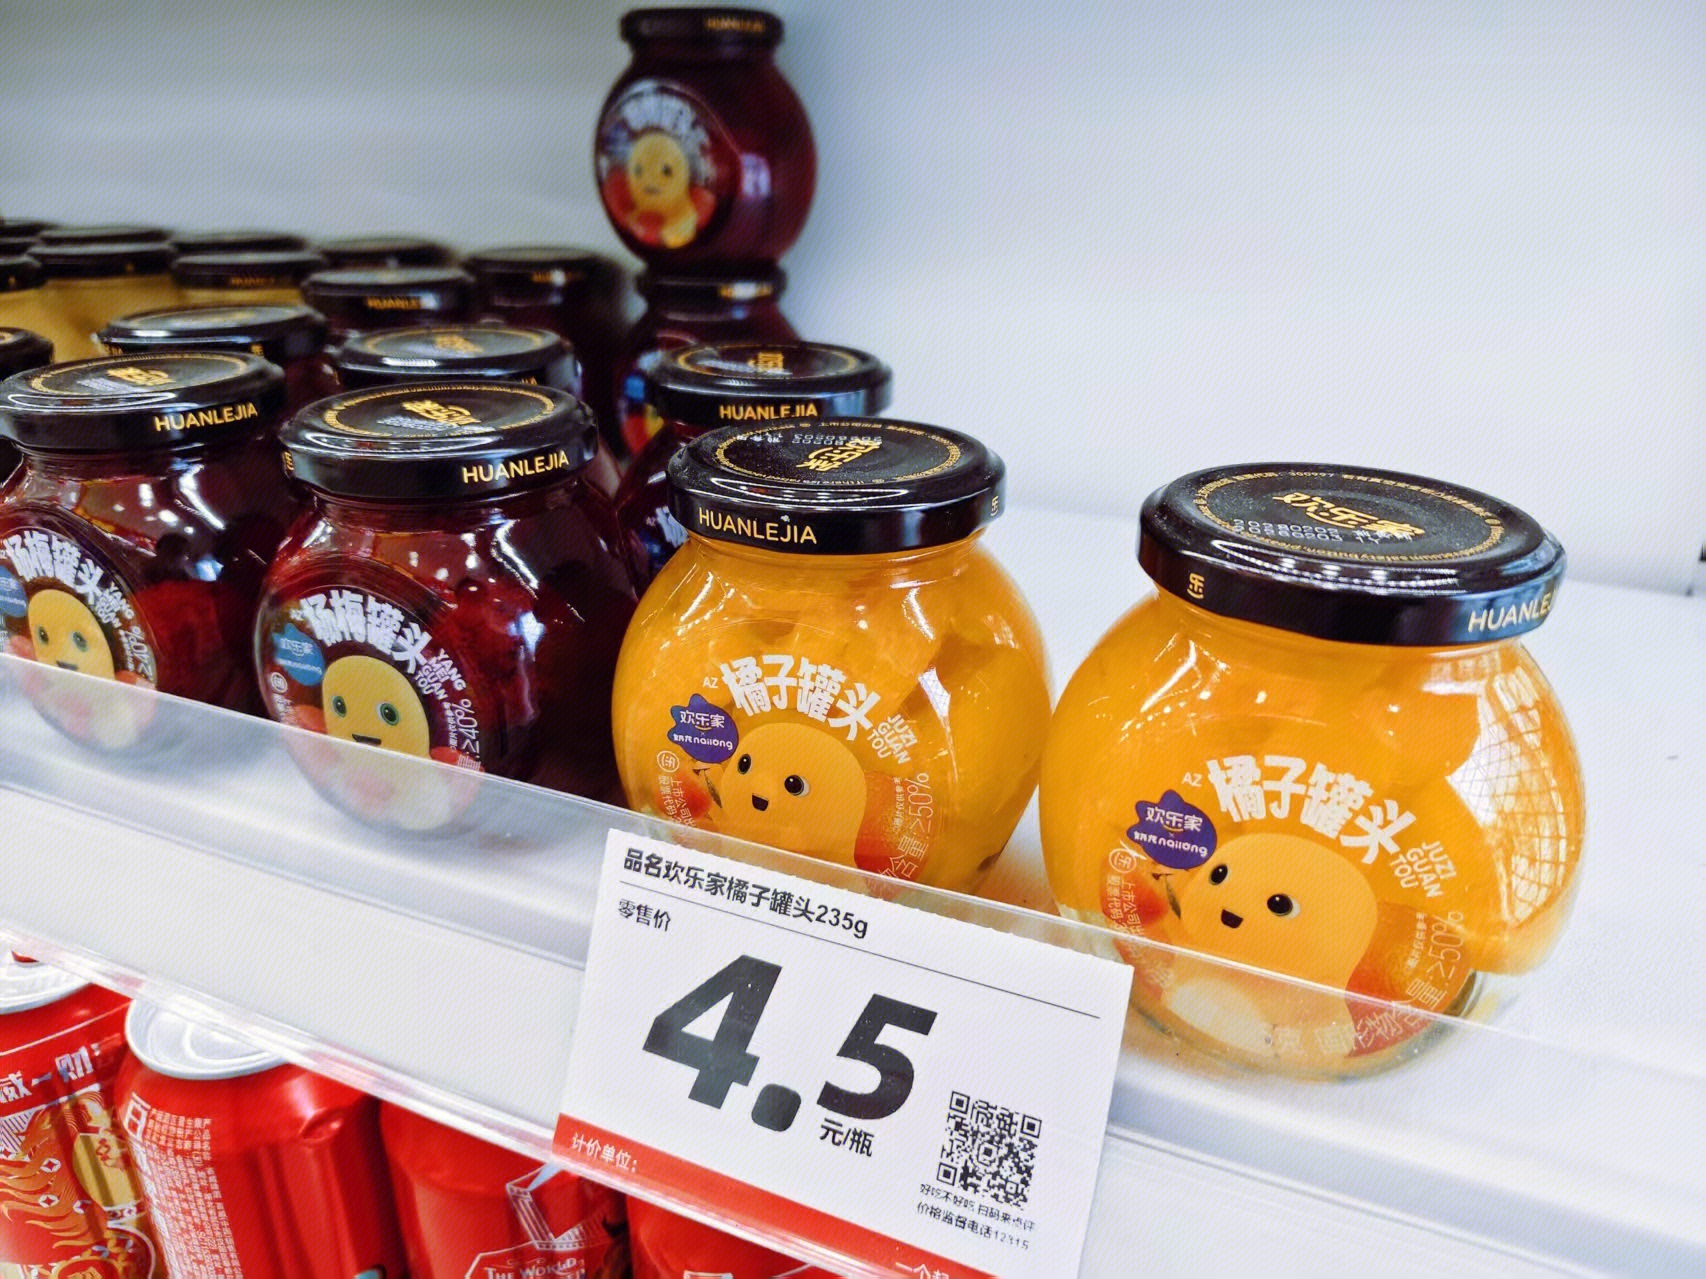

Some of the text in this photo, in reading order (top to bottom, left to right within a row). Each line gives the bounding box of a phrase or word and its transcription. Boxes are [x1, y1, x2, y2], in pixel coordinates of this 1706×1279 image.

[153, 402, 258, 432] HUANLEJIA
[719, 401, 819, 421] HUANLEJIA
[462, 450, 569, 484] HUANLEJIA
[699, 507, 817, 545] HUANLEJIA
[414, 670, 434, 695] TOU
[423, 665, 448, 700] GUAN
[440, 648, 466, 691] YANG
[702, 676, 719, 689] AZ
[720, 654, 881, 741] 橘子罐头
[680, 709, 725, 730] 欢乐家
[887, 714, 918, 748] JUZI
[866, 729, 892, 759] TOU
[877, 722, 911, 764] GUAN
[1182, 771, 1203, 788] AZ
[1145, 806, 1203, 833] 欢乐家
[1206, 754, 1416, 864] 橘子罐头
[1389, 854, 1419, 889] TOU
[1406, 847, 1443, 898] GUAN
[1421, 840, 1457, 879] JUZI
[623, 847, 868, 939] 品名欢乐家橘子罐头235g
[618, 898, 671, 932] 零售价
[641, 954, 939, 1133] 4.5
[571, 1131, 638, 1173] 计价单位:
[820, 1117, 875, 1157] 元/瓶
